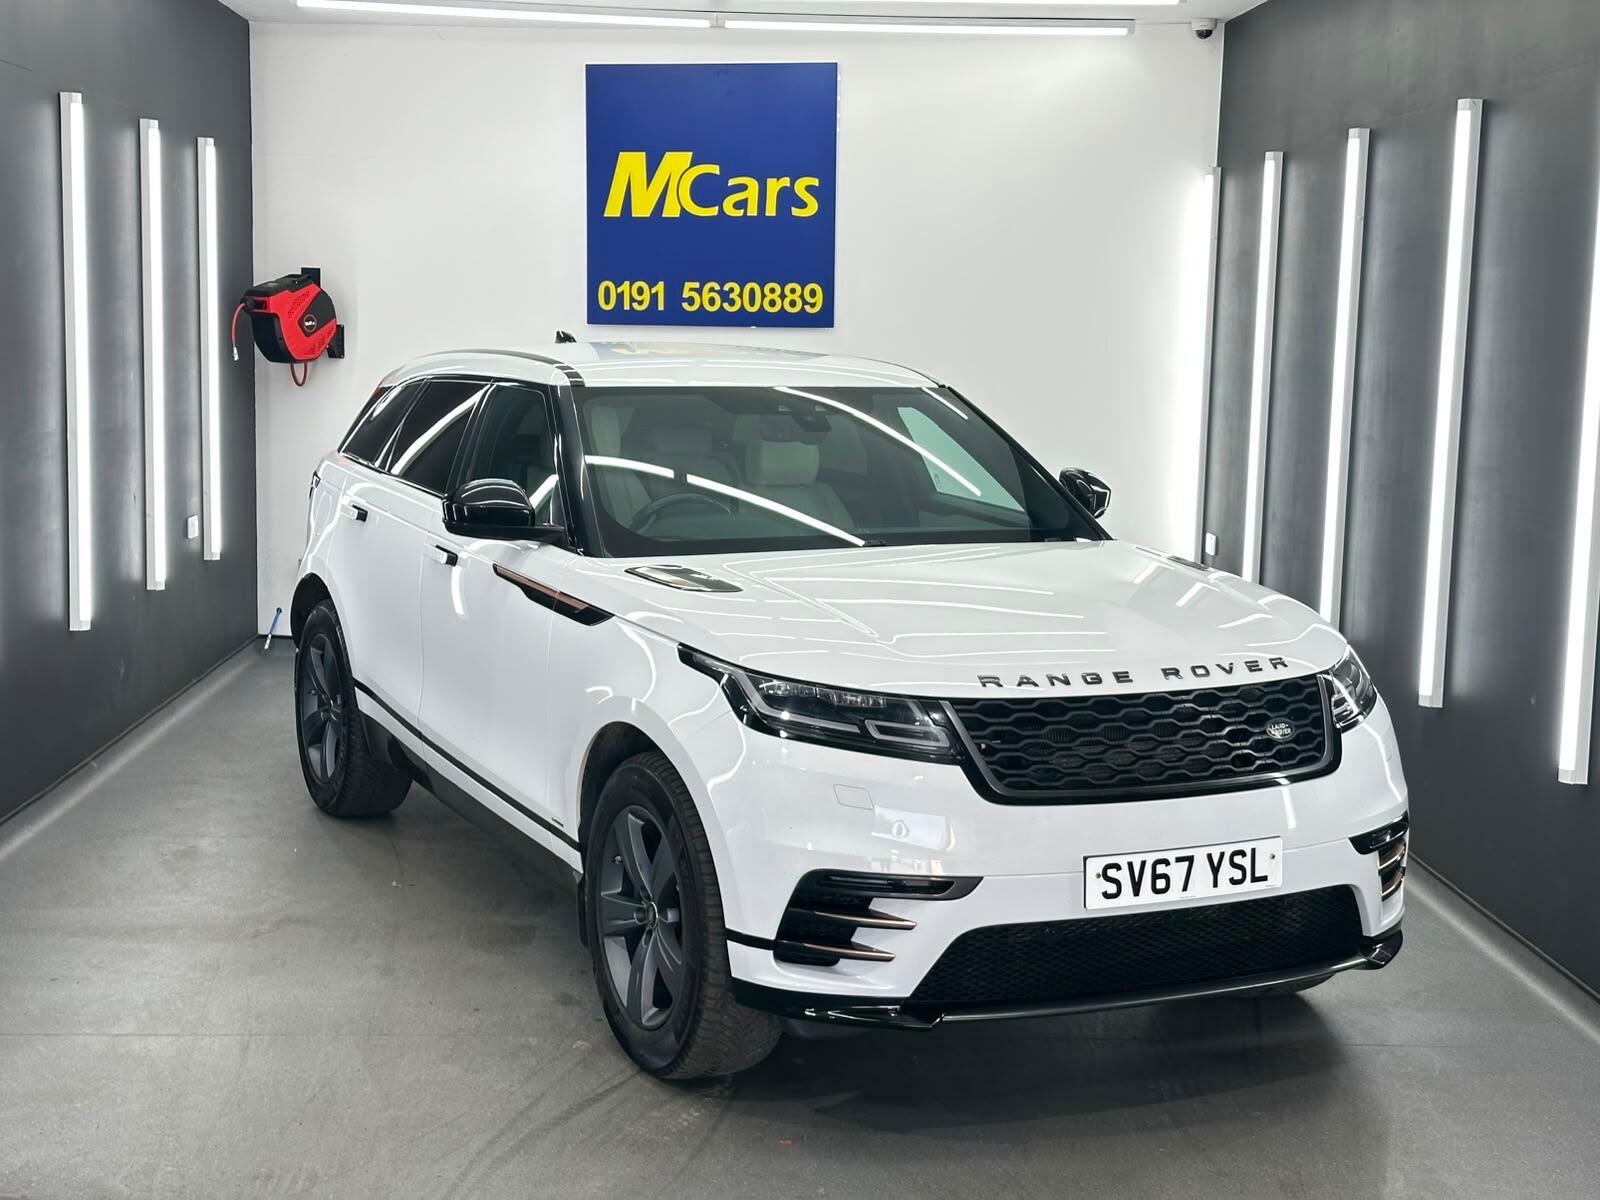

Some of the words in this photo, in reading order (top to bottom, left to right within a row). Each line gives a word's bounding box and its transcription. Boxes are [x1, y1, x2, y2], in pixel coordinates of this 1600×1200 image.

[603, 151, 820, 218] MCars
[598, 280, 665, 311] 0191
[681, 281, 823, 313] 5630889
[977, 671, 1134, 689] RANGE
[1161, 656, 1289, 680] ROVER
[1101, 854, 1195, 900] SV67
[1206, 847, 1268, 889] YSL
